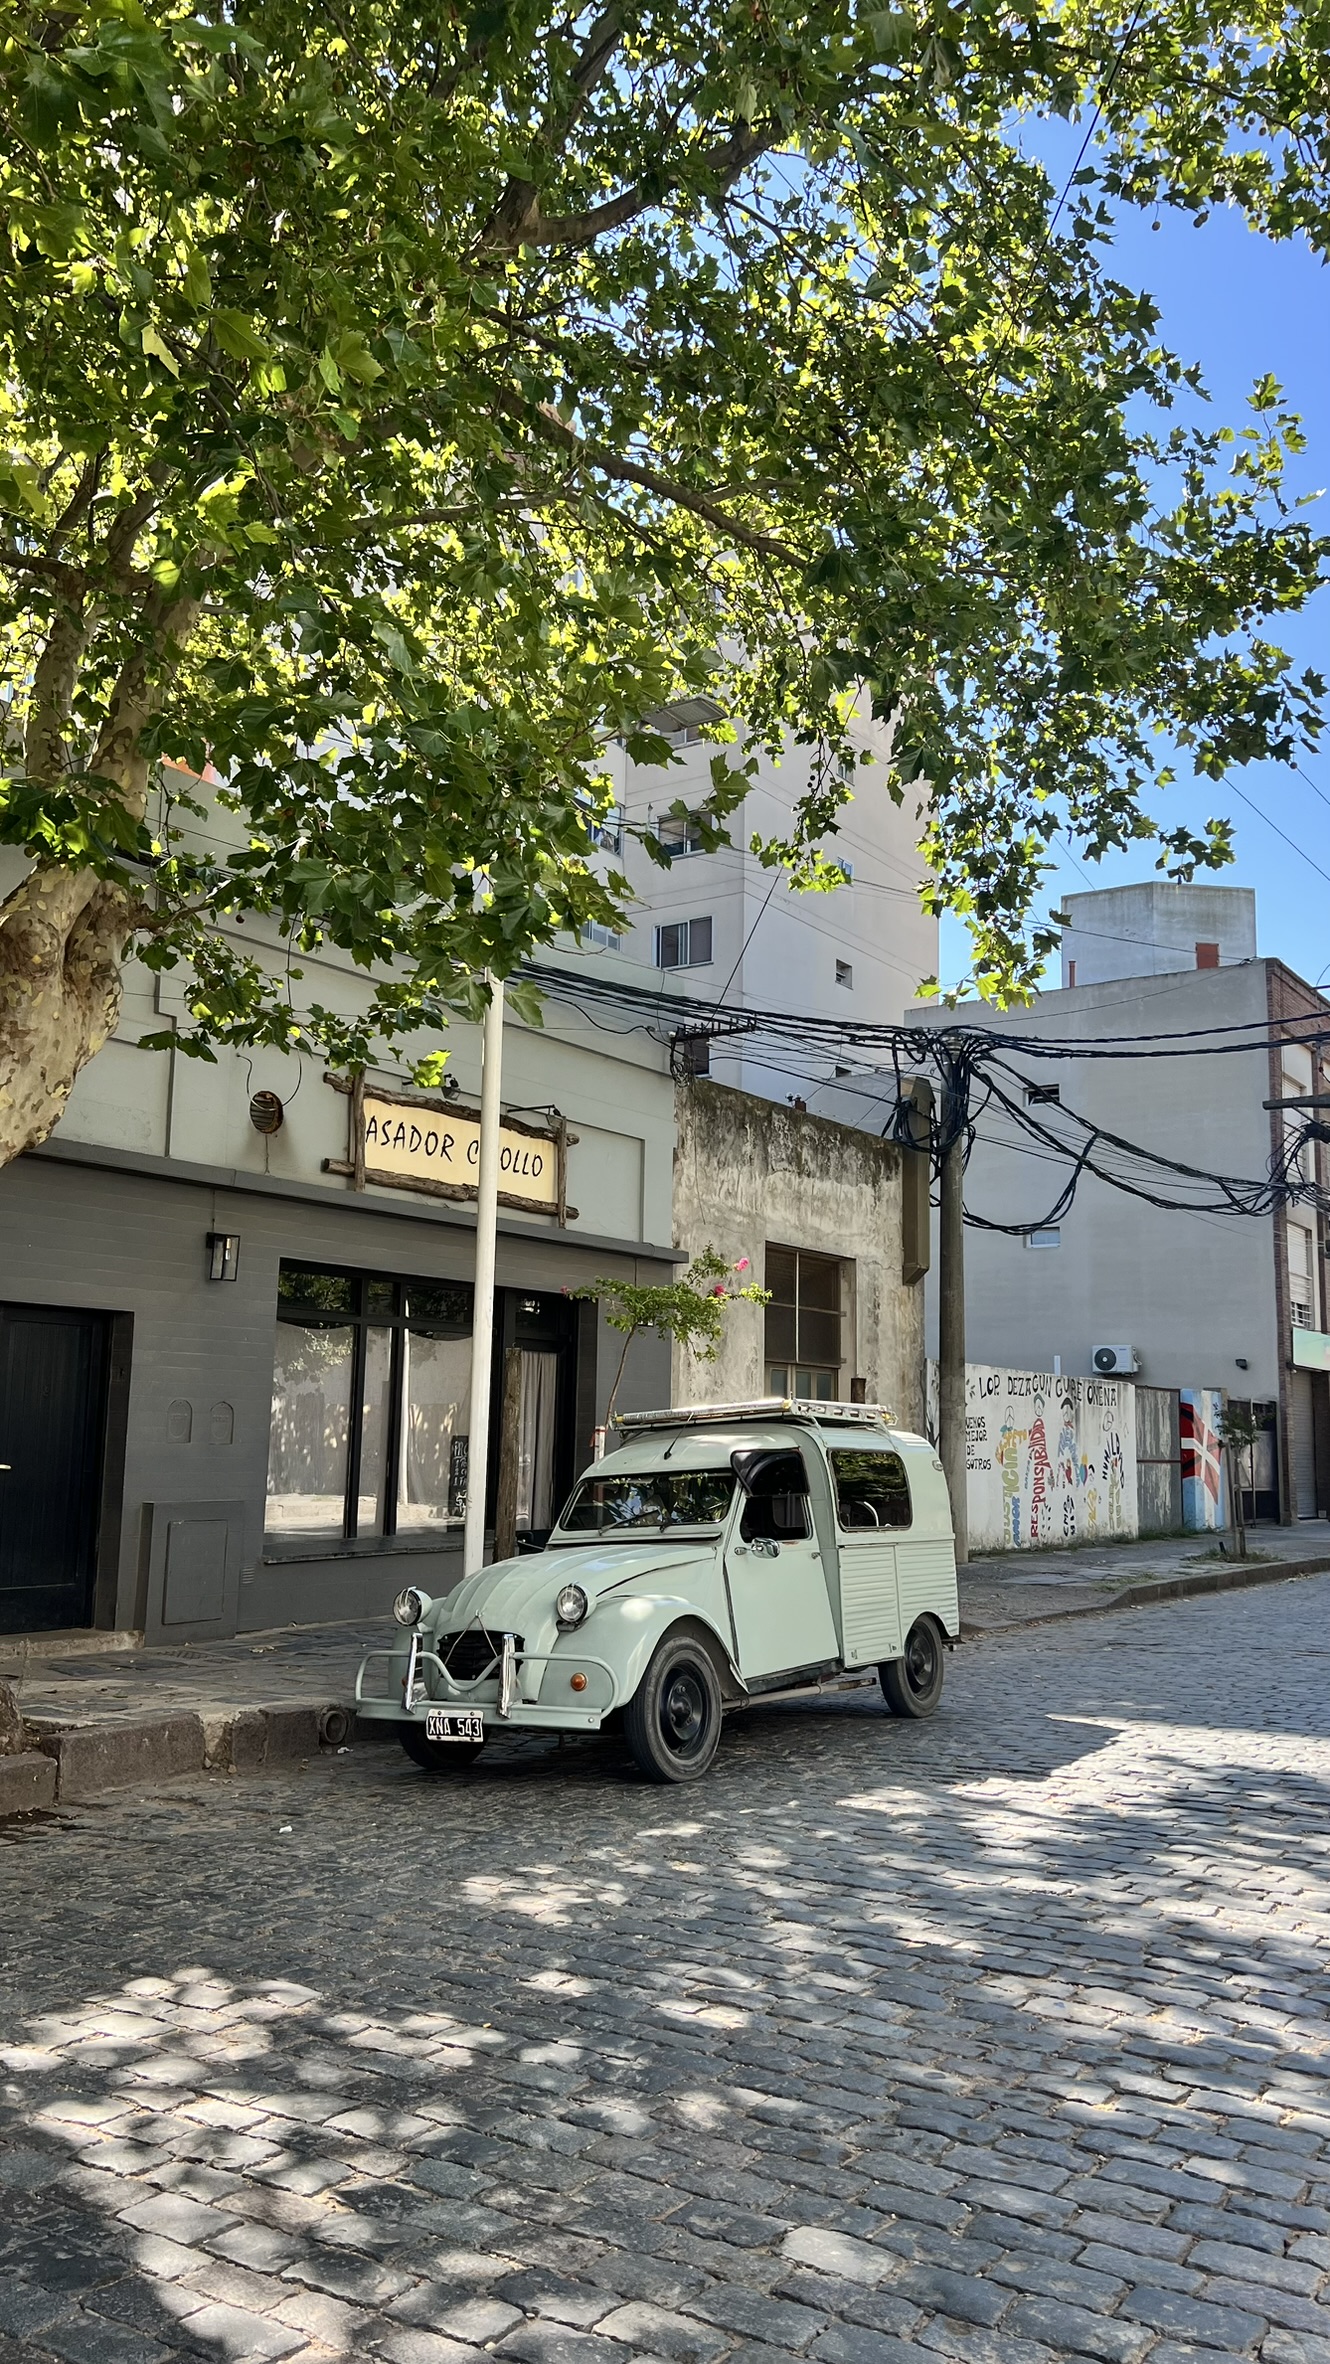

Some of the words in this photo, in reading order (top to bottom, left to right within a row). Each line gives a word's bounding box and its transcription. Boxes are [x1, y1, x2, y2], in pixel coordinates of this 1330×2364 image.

[365, 1115, 455, 1162] ASADOR
[467, 1139, 544, 1178] COLLO
[1008, 1374, 1051, 1398] DEZAGUN
[967, 1445, 975, 1455] DE
[429, 1717, 451, 1735] XNA
[457, 1718, 480, 1736] 543
